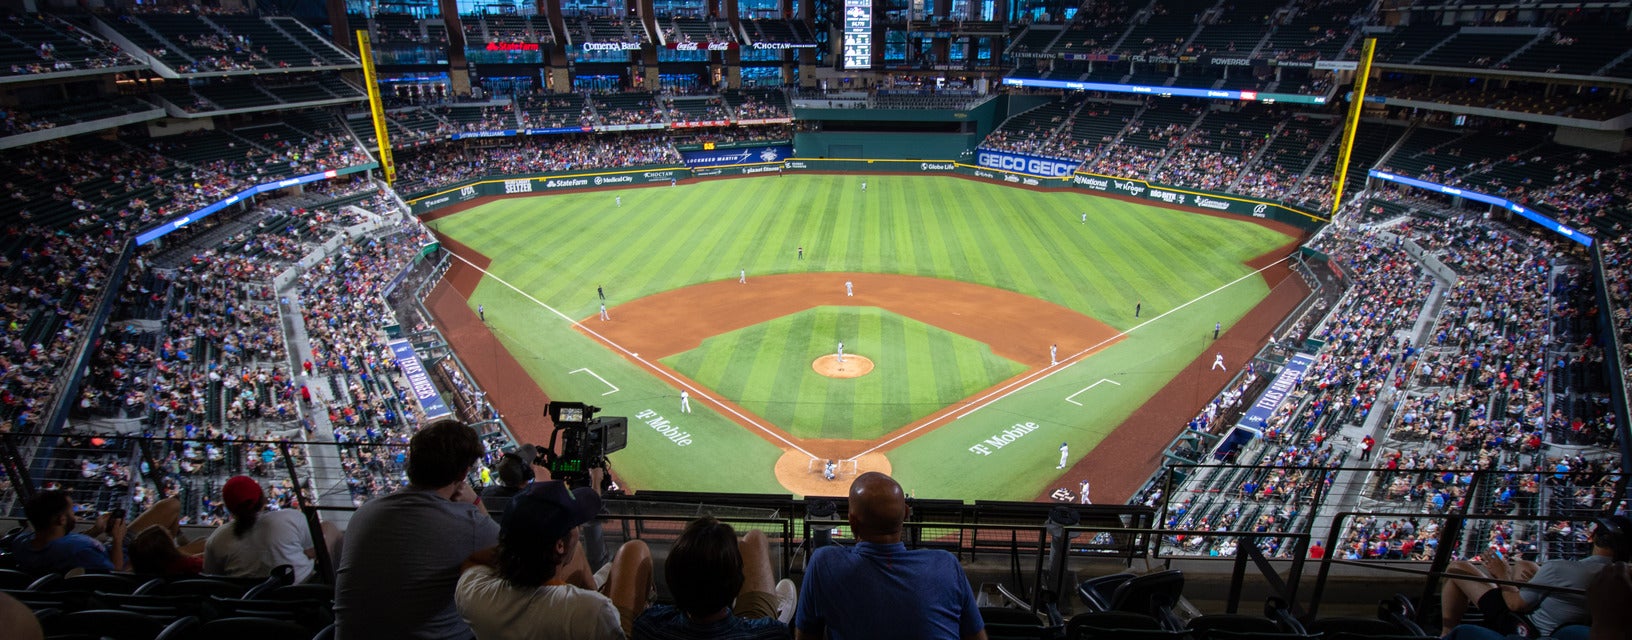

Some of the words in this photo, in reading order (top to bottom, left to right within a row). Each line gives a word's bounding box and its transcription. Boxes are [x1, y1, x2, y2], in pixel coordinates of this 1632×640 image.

[621, 42, 641, 50] Bank
[1210, 58, 1250, 66] POWERADE
[978, 152, 1026, 172] GEICO
[646, 170, 673, 178] CHOCTAW
[504, 182, 533, 194] SELTZER
[1080, 176, 1108, 188] National
[460, 186, 475, 197] UTA
[1122, 180, 1145, 197] Kroger
[401, 355, 422, 376] TEXAS
[409, 371, 437, 400] RANGERS
[1256, 390, 1283, 410] TEXAS
[1271, 368, 1301, 396] RANGERS
